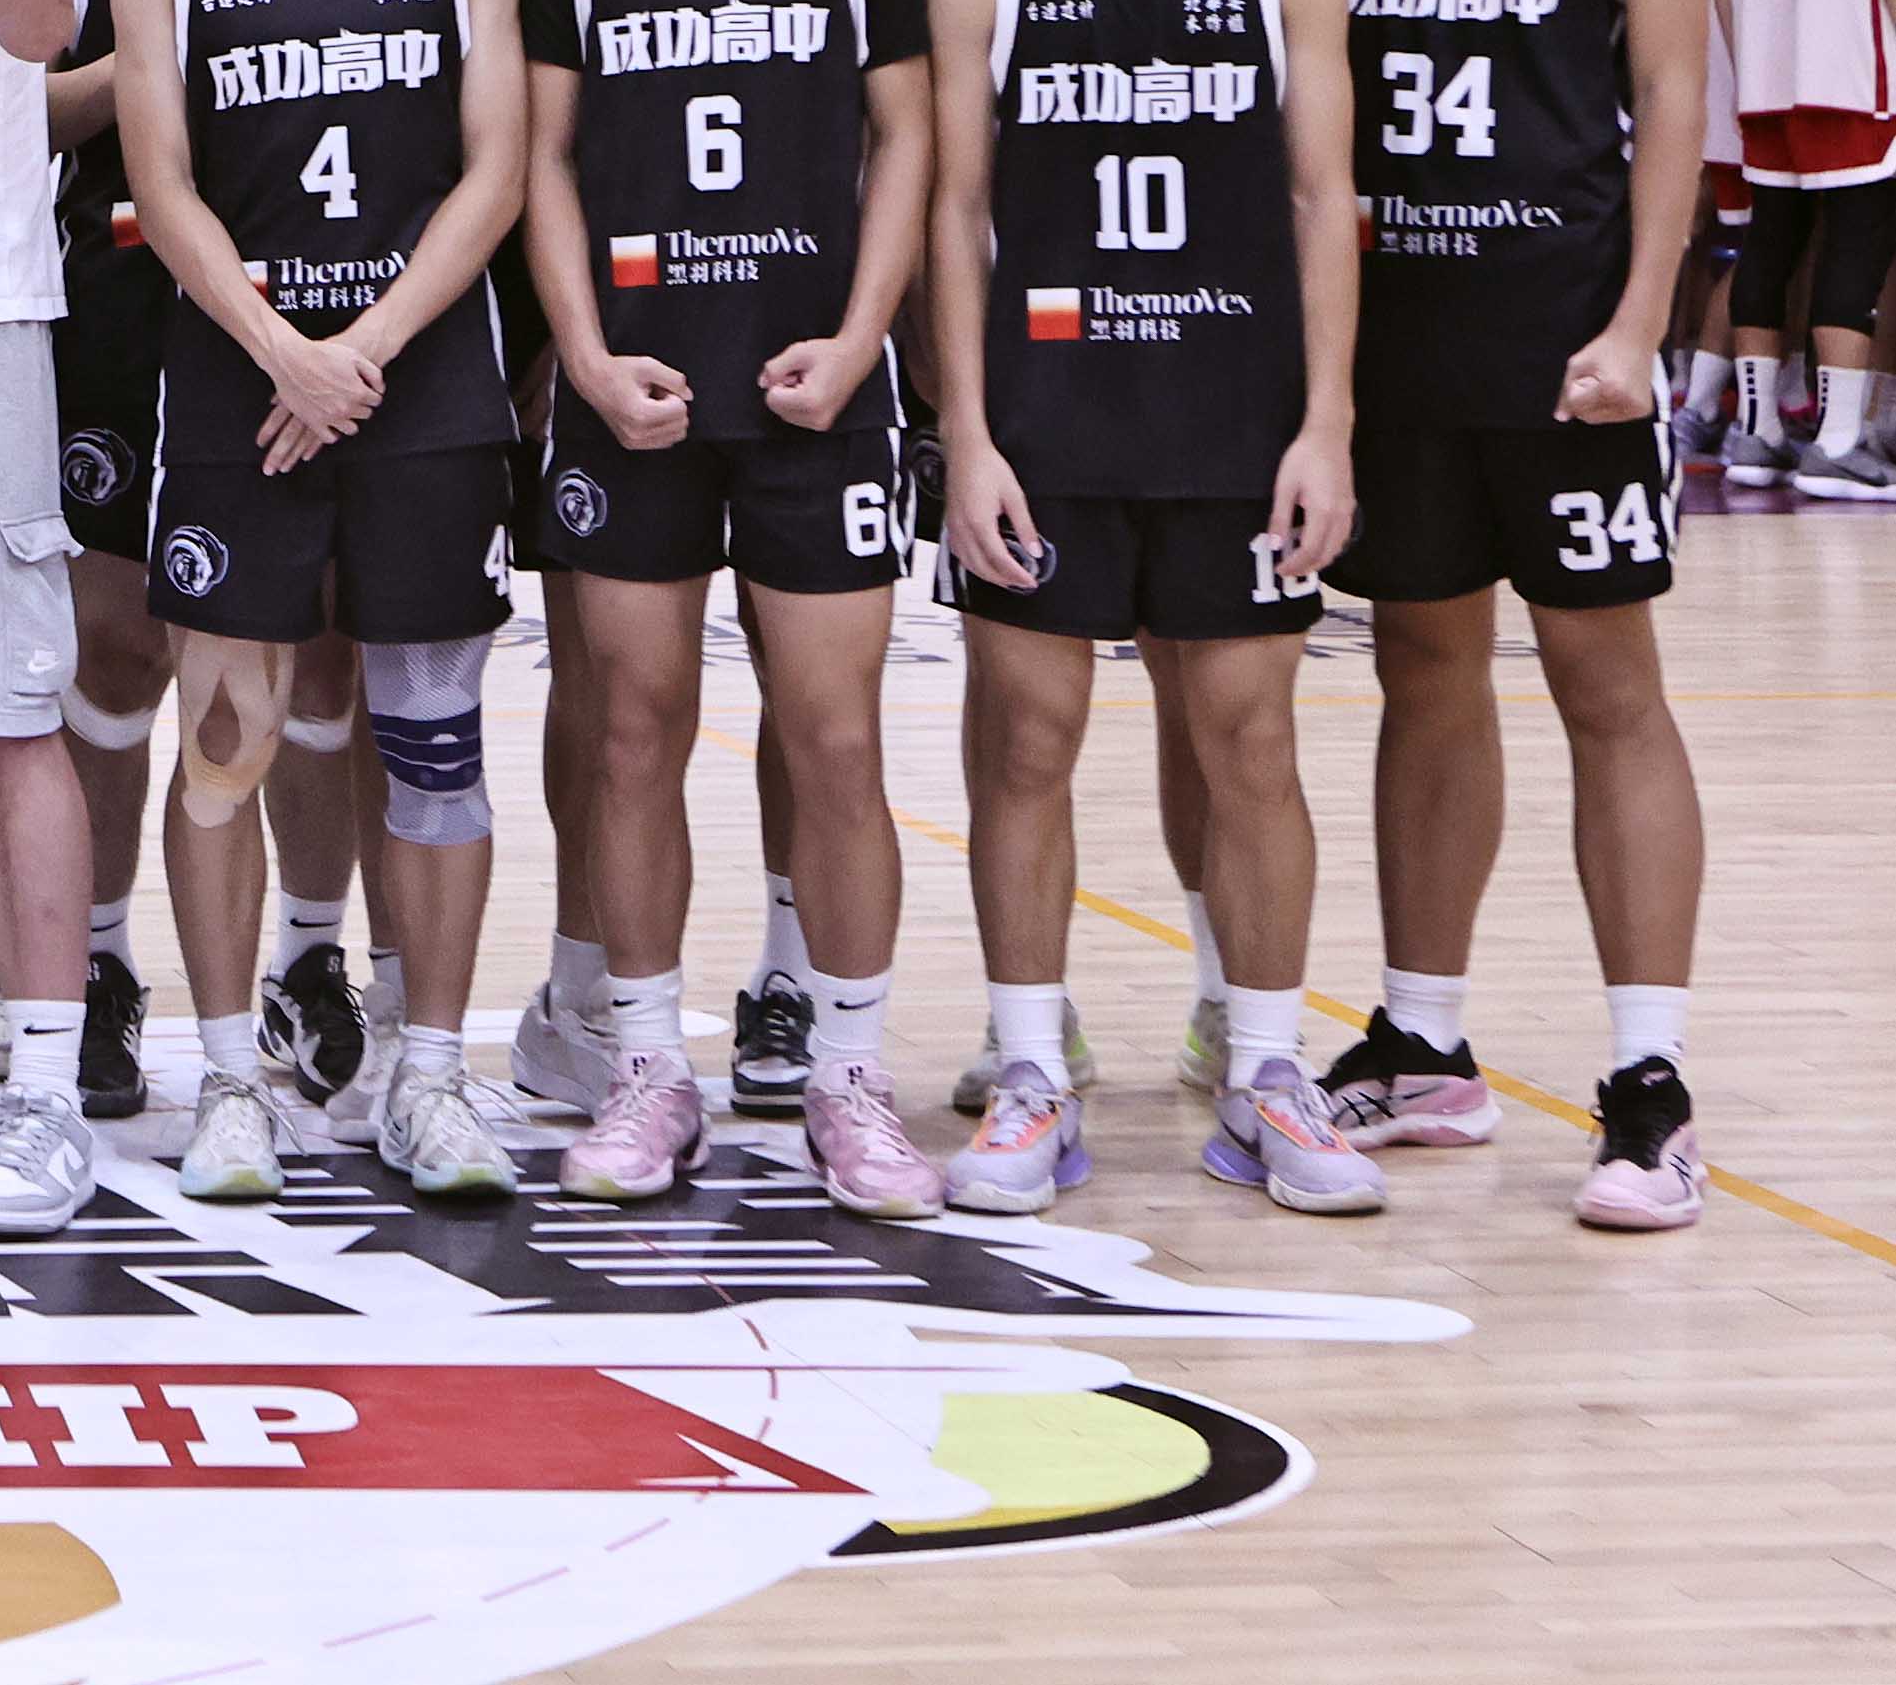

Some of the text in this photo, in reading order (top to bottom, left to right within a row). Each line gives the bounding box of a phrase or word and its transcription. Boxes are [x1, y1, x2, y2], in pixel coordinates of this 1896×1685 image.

[207, 27, 442, 111] 成功高中
[1017, 57, 1259, 125] 成功高中
[1381, 51, 1496, 157] 34
[299, 125, 359, 219] 4
[685, 94, 745, 192] 6
[1093, 154, 1187, 251] 10
[274, 250, 407, 284] Thermo
[842, 482, 889, 560] 6
[1550, 481, 1665, 572] 34
